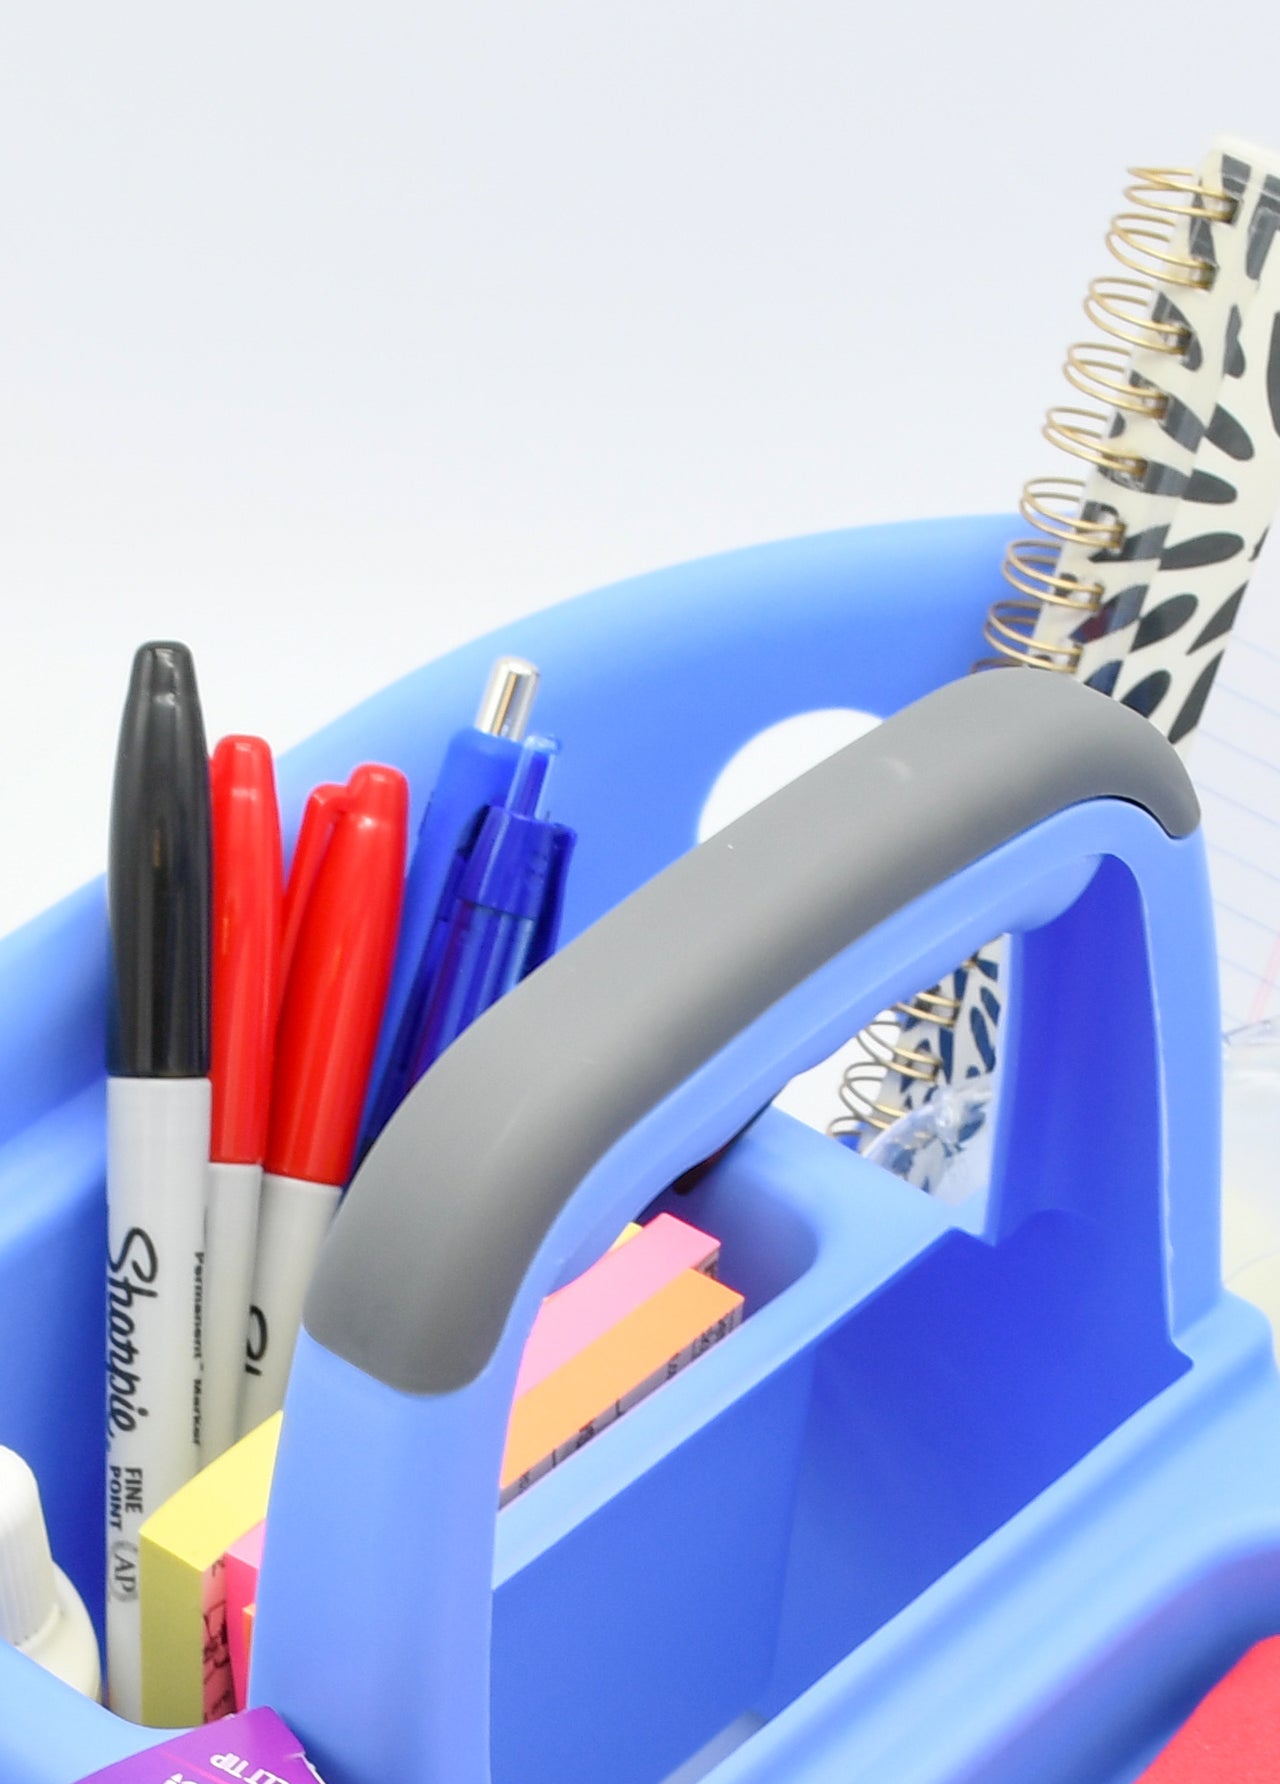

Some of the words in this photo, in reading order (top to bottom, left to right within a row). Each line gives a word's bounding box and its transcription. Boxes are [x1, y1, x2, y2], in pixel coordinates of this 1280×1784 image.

[109, 1464, 124, 1531] POINT
[124, 1467, 143, 1514] FINE
[209, 1752, 249, 1779] TIP
